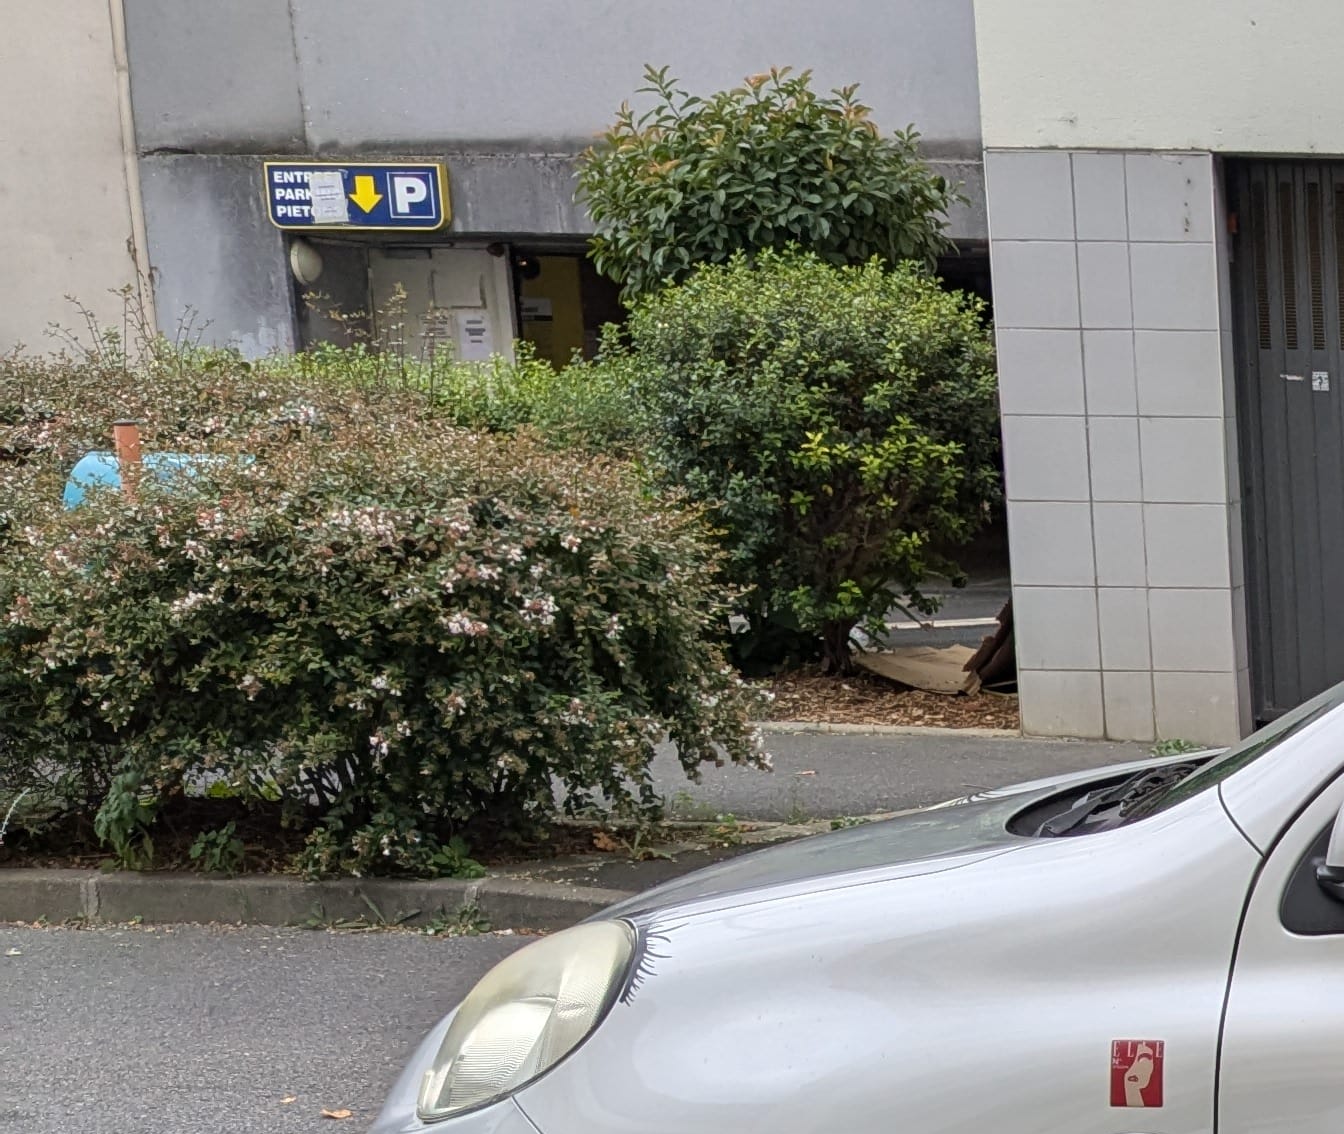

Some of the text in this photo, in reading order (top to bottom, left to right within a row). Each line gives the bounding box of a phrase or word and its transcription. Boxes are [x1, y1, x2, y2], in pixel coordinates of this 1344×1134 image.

[273, 170, 314, 184] ENTR
[274, 188, 313, 200] PARK
[393, 176, 427, 213] P
[276, 205, 315, 218] PIET
